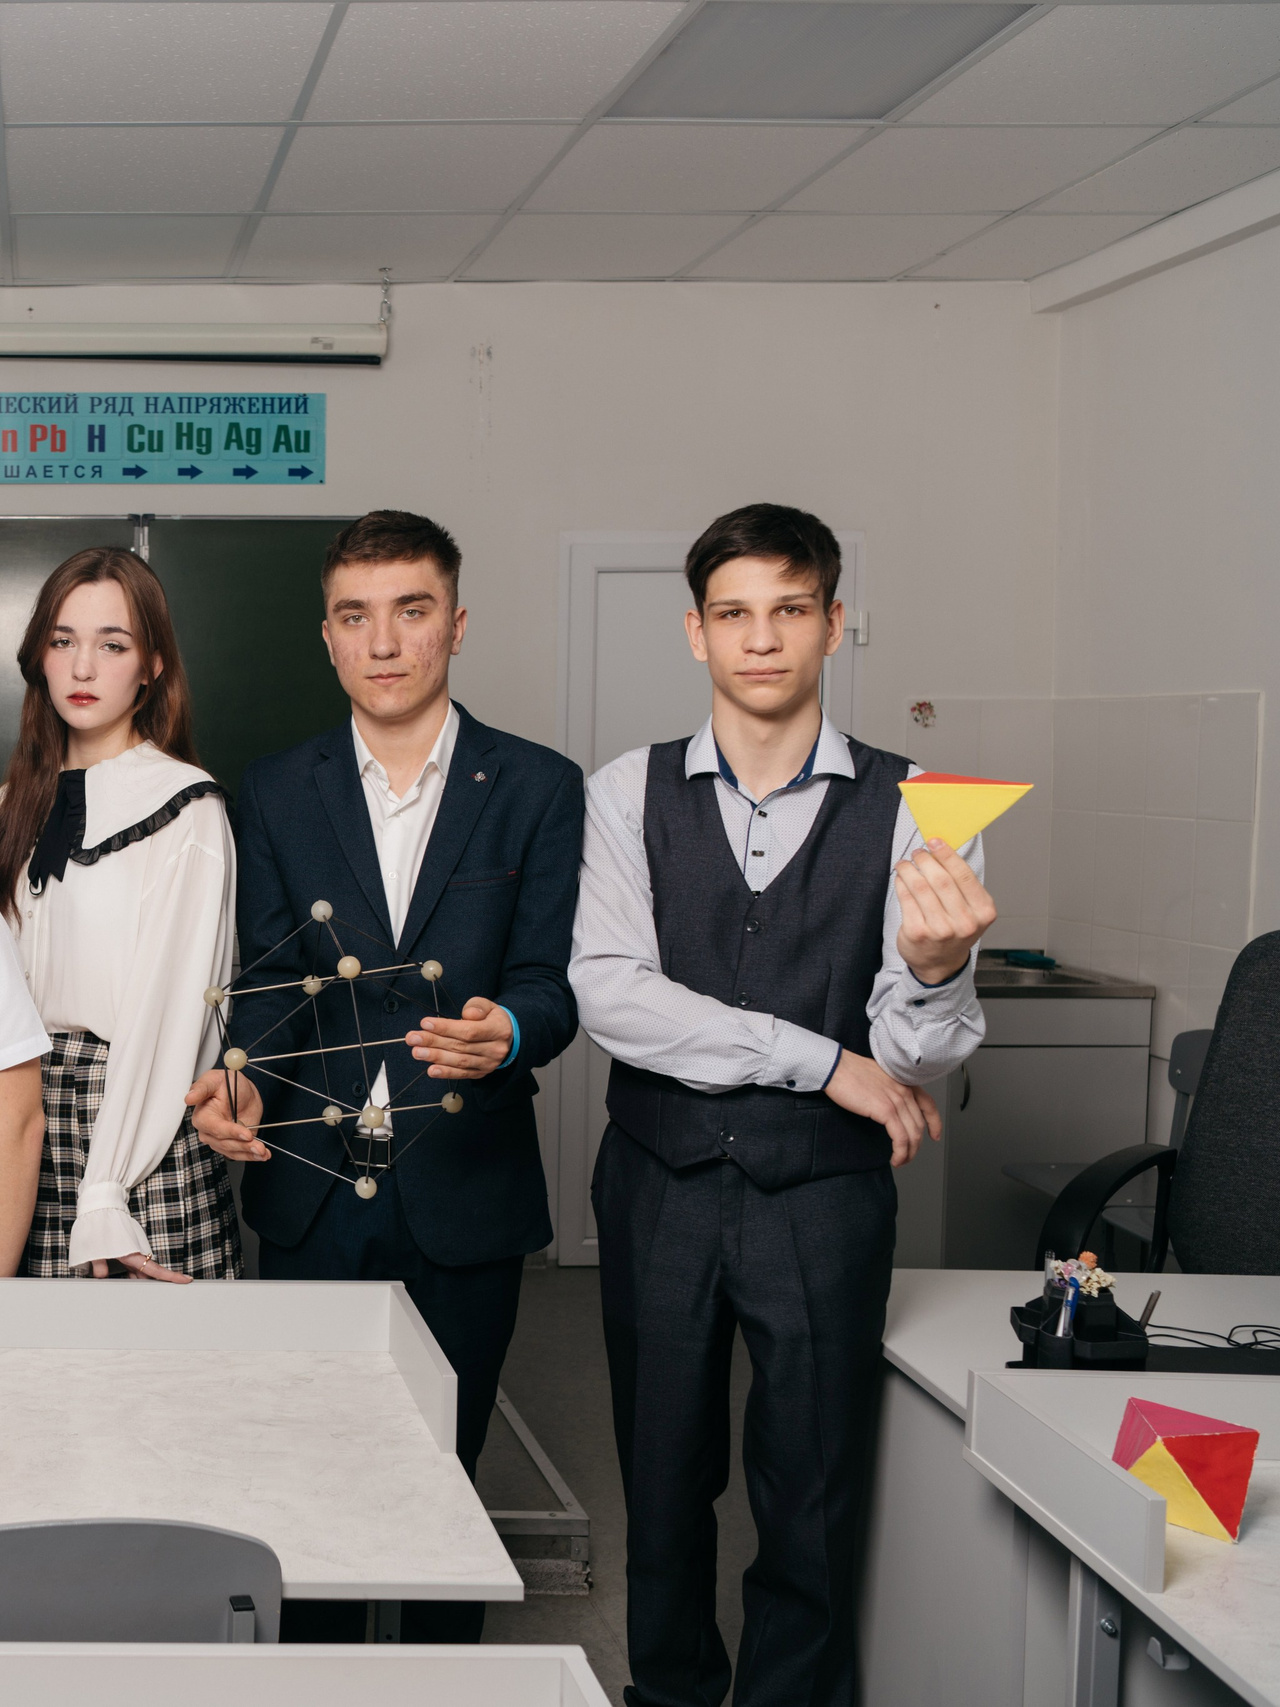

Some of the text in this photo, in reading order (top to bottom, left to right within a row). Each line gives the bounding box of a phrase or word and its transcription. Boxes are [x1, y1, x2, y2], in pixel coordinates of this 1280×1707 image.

[89, 396, 134, 417] РЯД
[143, 394, 310, 415] НАПРЯЖЕНИЙ
[29, 424, 67, 453] Pb
[87, 424, 106, 453] H
[127, 424, 164, 453] Cu
[175, 422, 212, 455] Hg
[223, 422, 262, 455] Ag
[272, 424, 310, 453] Au
